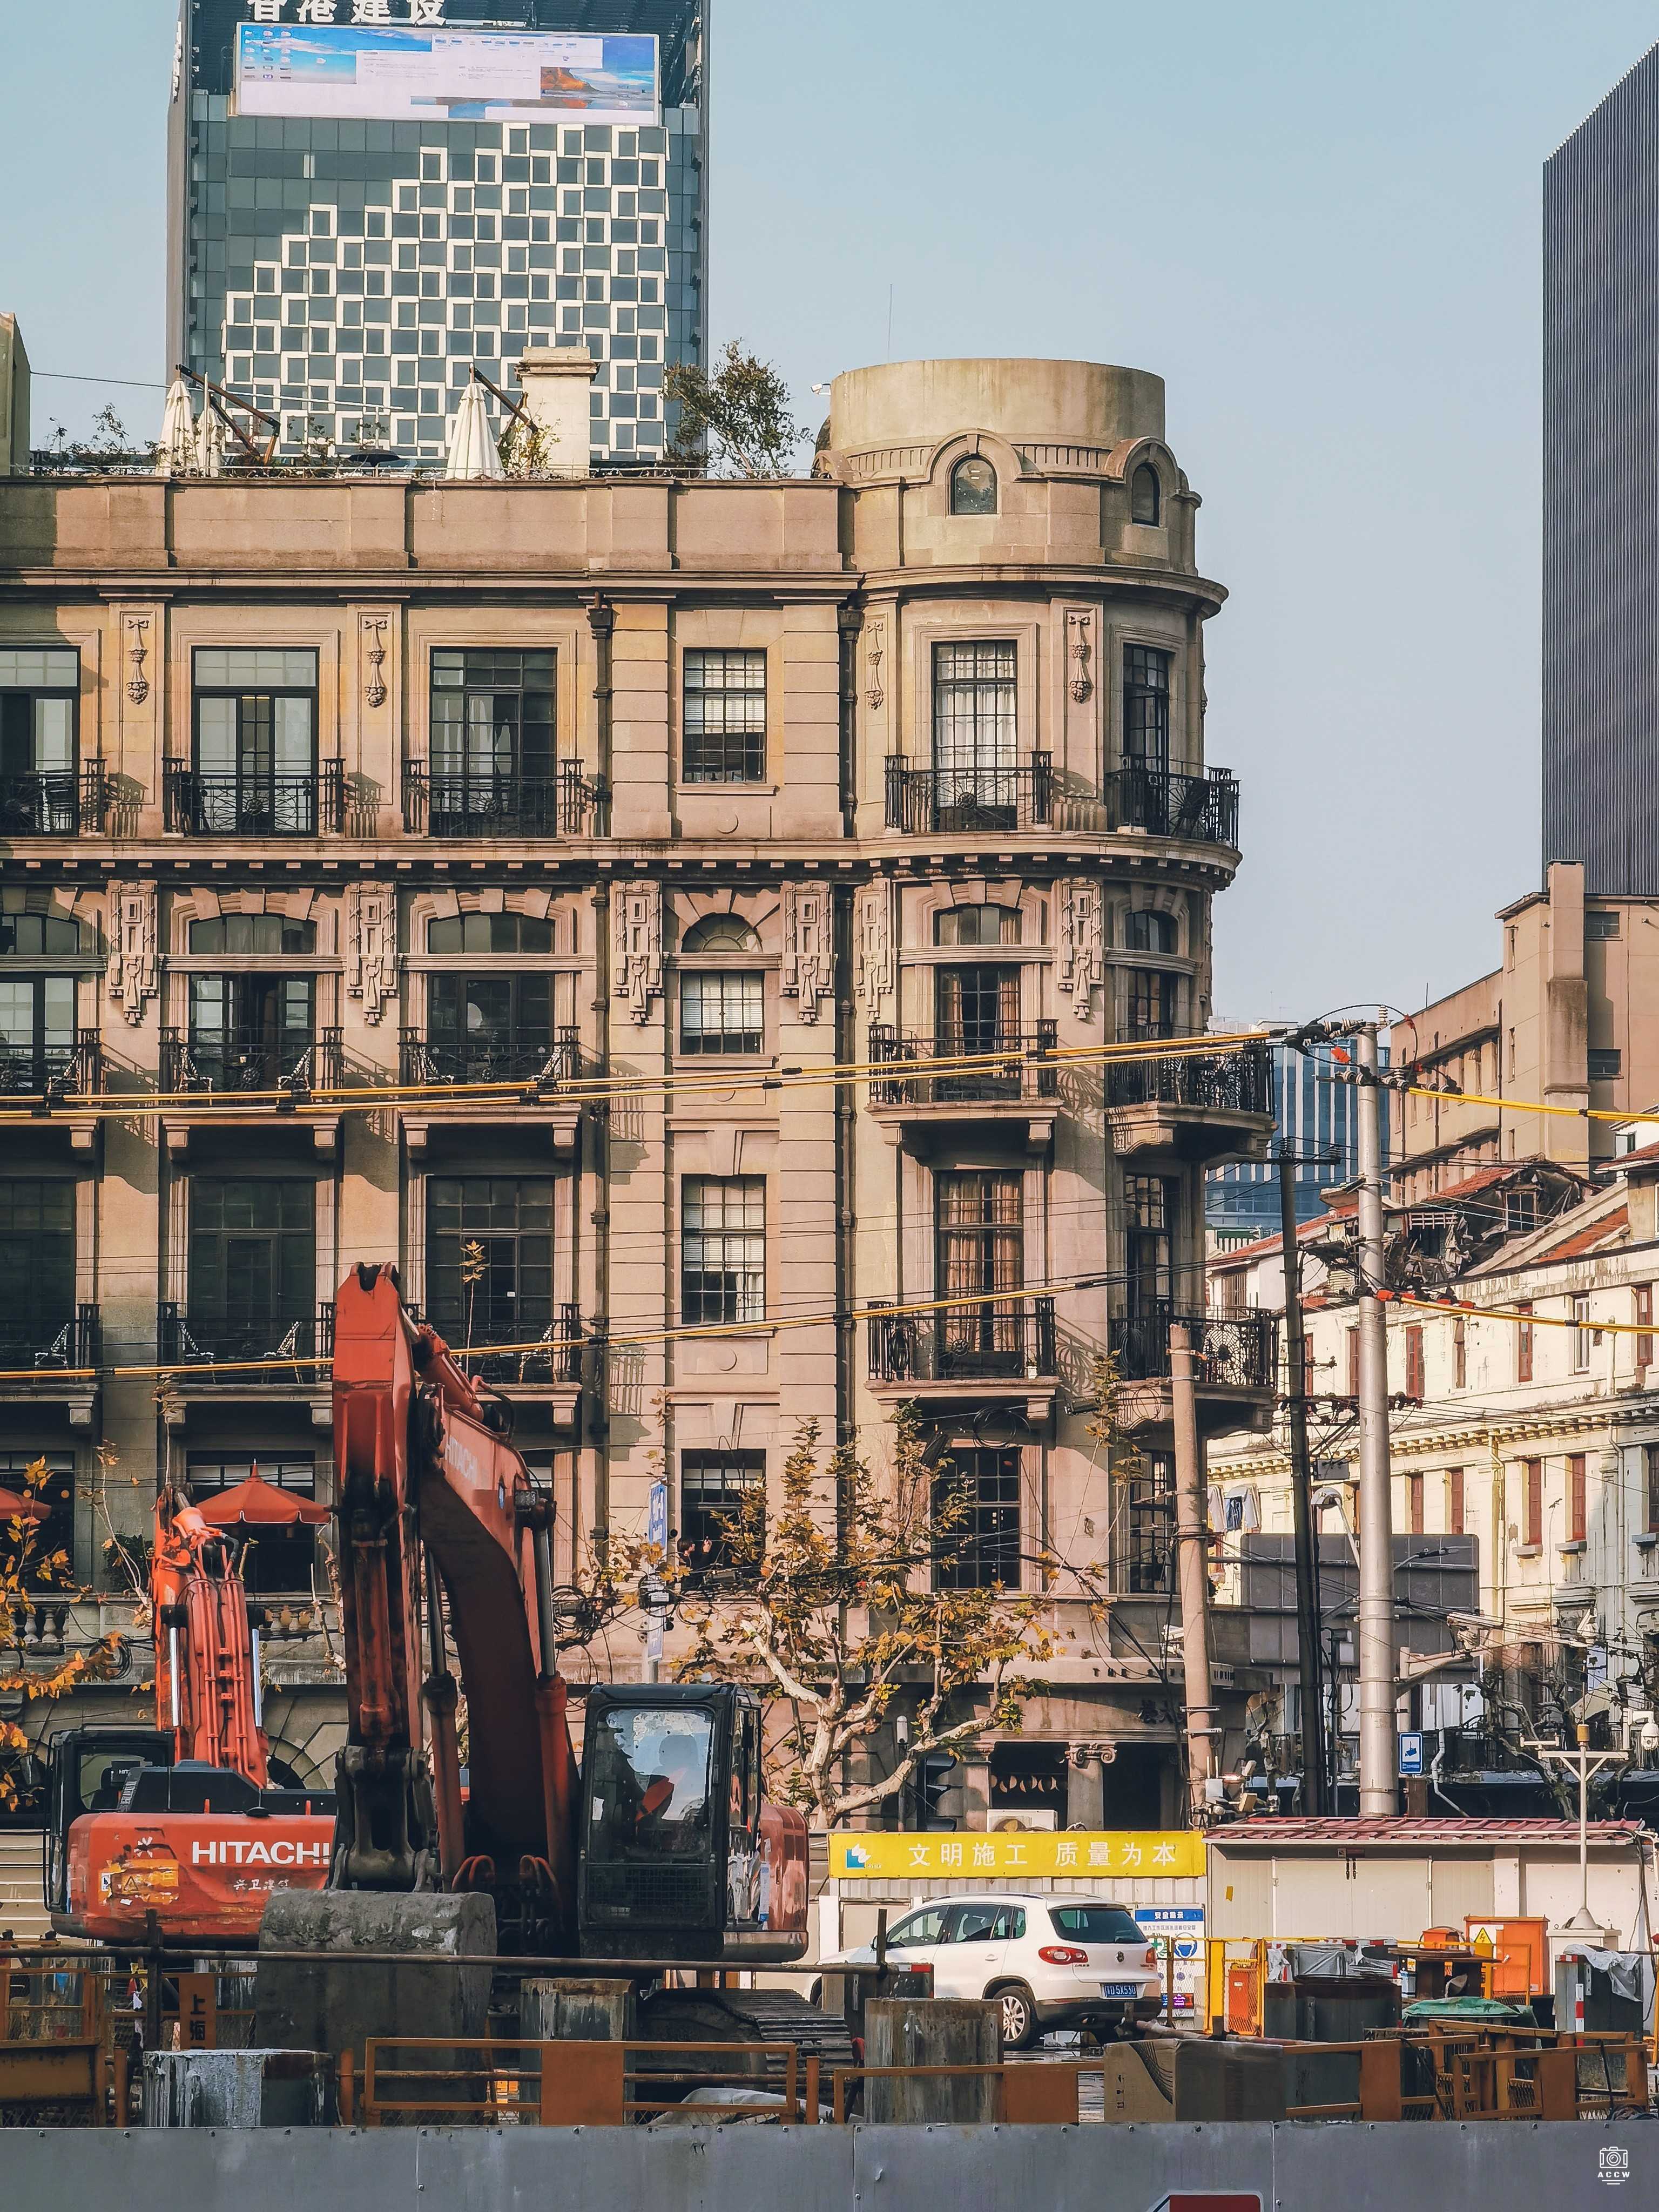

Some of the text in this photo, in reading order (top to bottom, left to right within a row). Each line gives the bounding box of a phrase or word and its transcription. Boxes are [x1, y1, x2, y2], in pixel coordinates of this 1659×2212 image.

[192, 1841, 330, 1865] HITACHI
[908, 1842, 1177, 1866] 文明施工 质量为本
